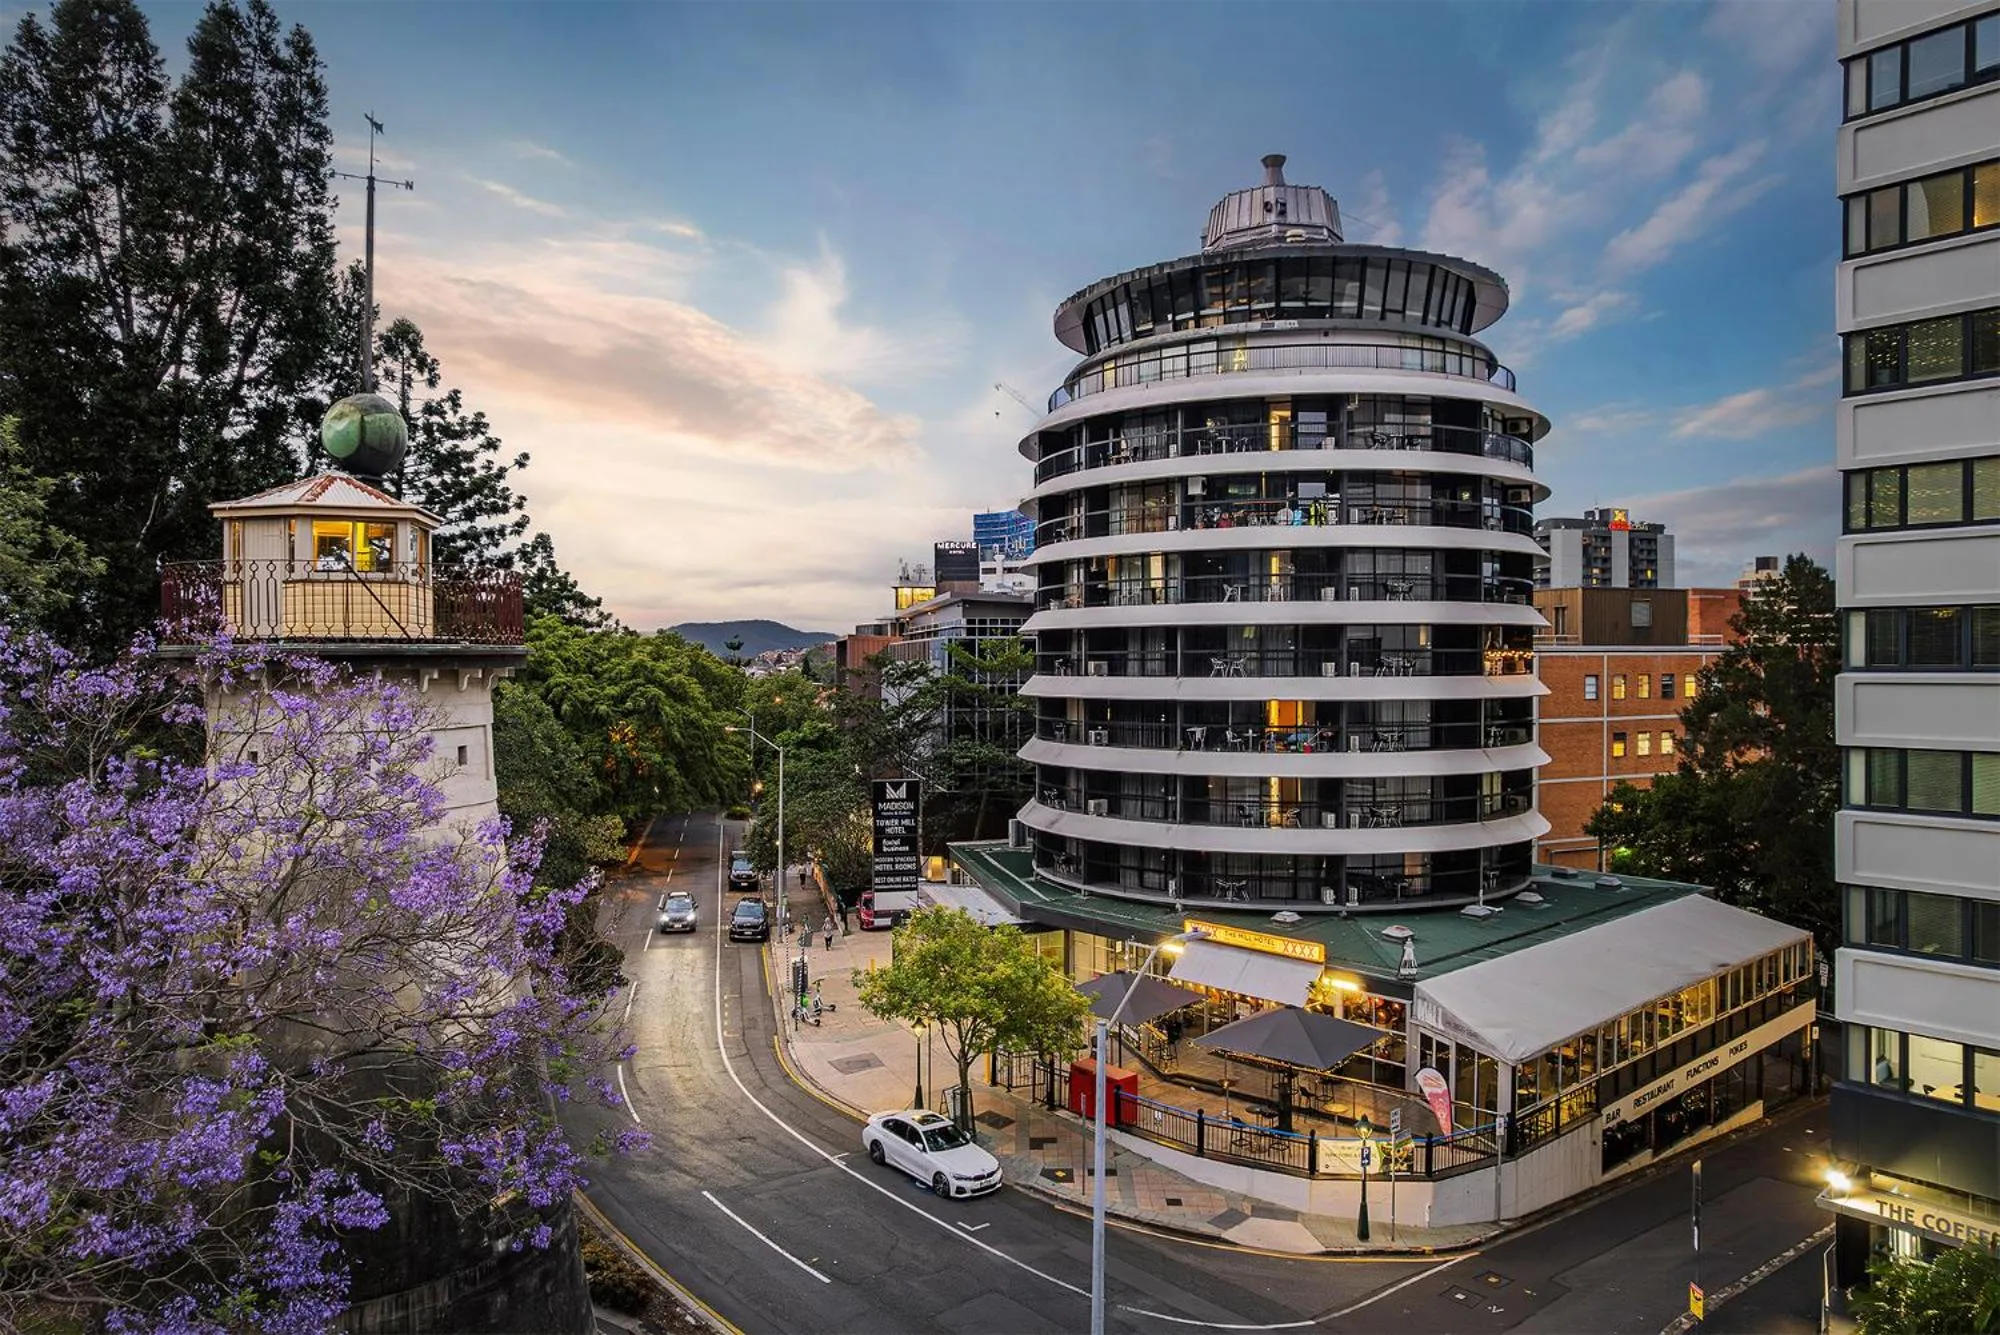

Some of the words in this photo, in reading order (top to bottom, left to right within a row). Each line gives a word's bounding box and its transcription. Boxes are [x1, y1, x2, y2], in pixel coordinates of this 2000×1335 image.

[878, 801, 914, 810] MADISON
[901, 818, 915, 826] MILL
[885, 826, 906, 834] HOTEL
[875, 863, 892, 871] HOTEL
[895, 862, 916, 870] ROOMS
[1254, 937, 1275, 946] HOTEL
[1283, 940, 1314, 958] XXXX
[1606, 1108, 1621, 1123] BAR
[1633, 1079, 1674, 1109] RESTAURANT
[1686, 1056, 1719, 1081] FUNCTIONS
[1363, 1148, 1369, 1158] P
[1876, 1200, 1915, 1225] THE
